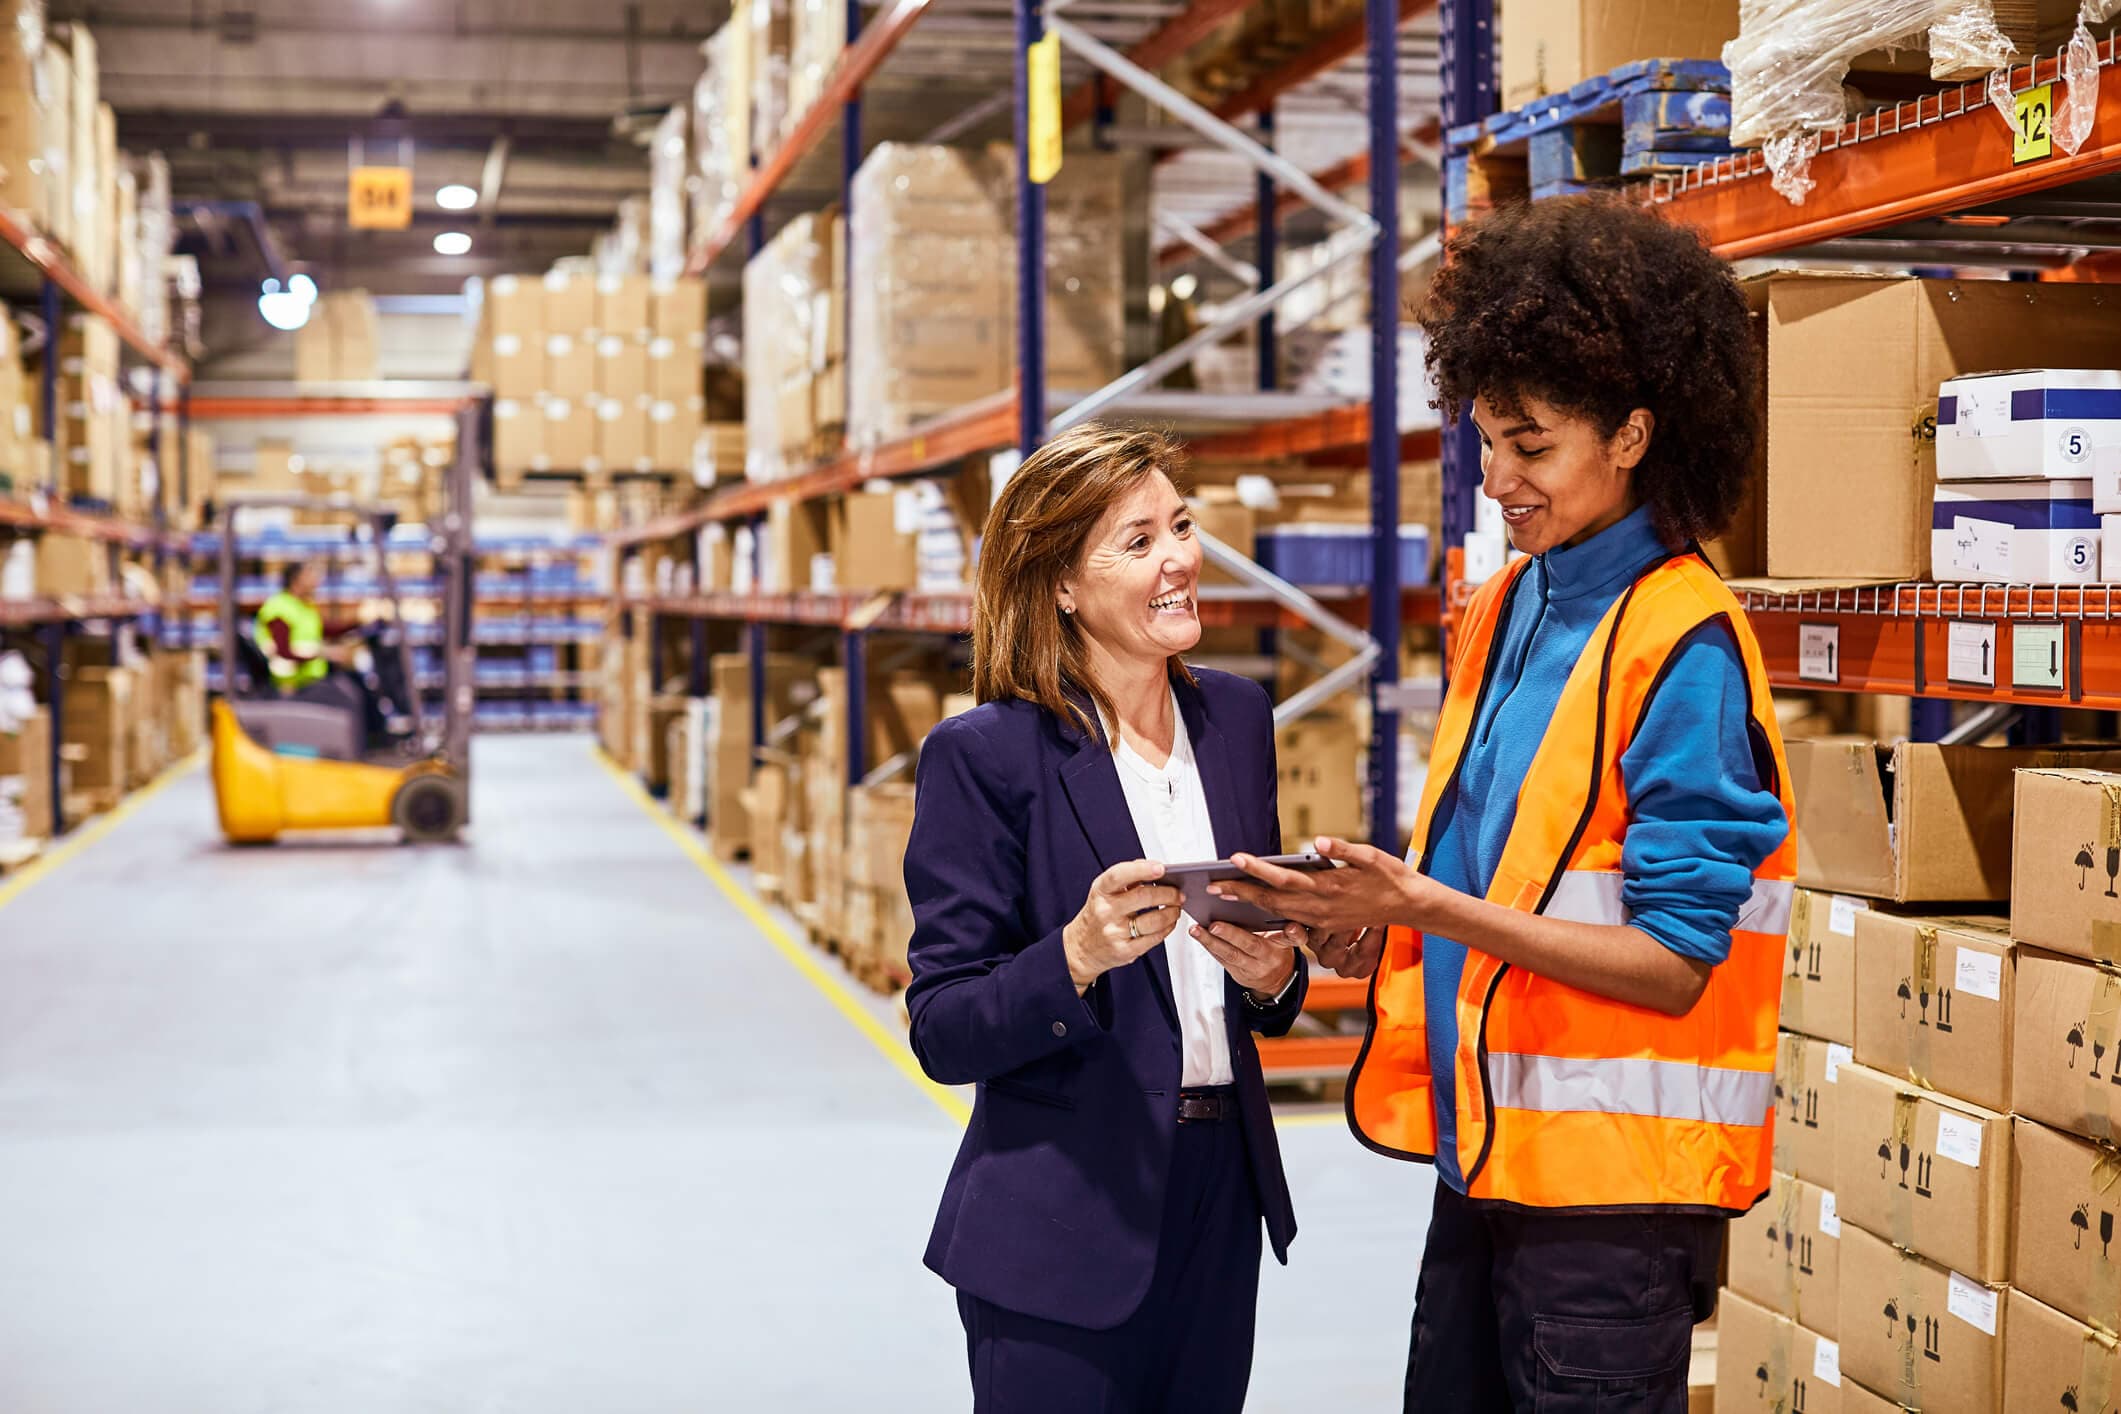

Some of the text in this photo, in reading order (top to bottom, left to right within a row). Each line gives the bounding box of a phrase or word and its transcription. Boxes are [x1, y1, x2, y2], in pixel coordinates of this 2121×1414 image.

[2020, 102, 2046, 144] 12
[2069, 435, 2082, 455] 5
[2073, 544, 2086, 565] 5
